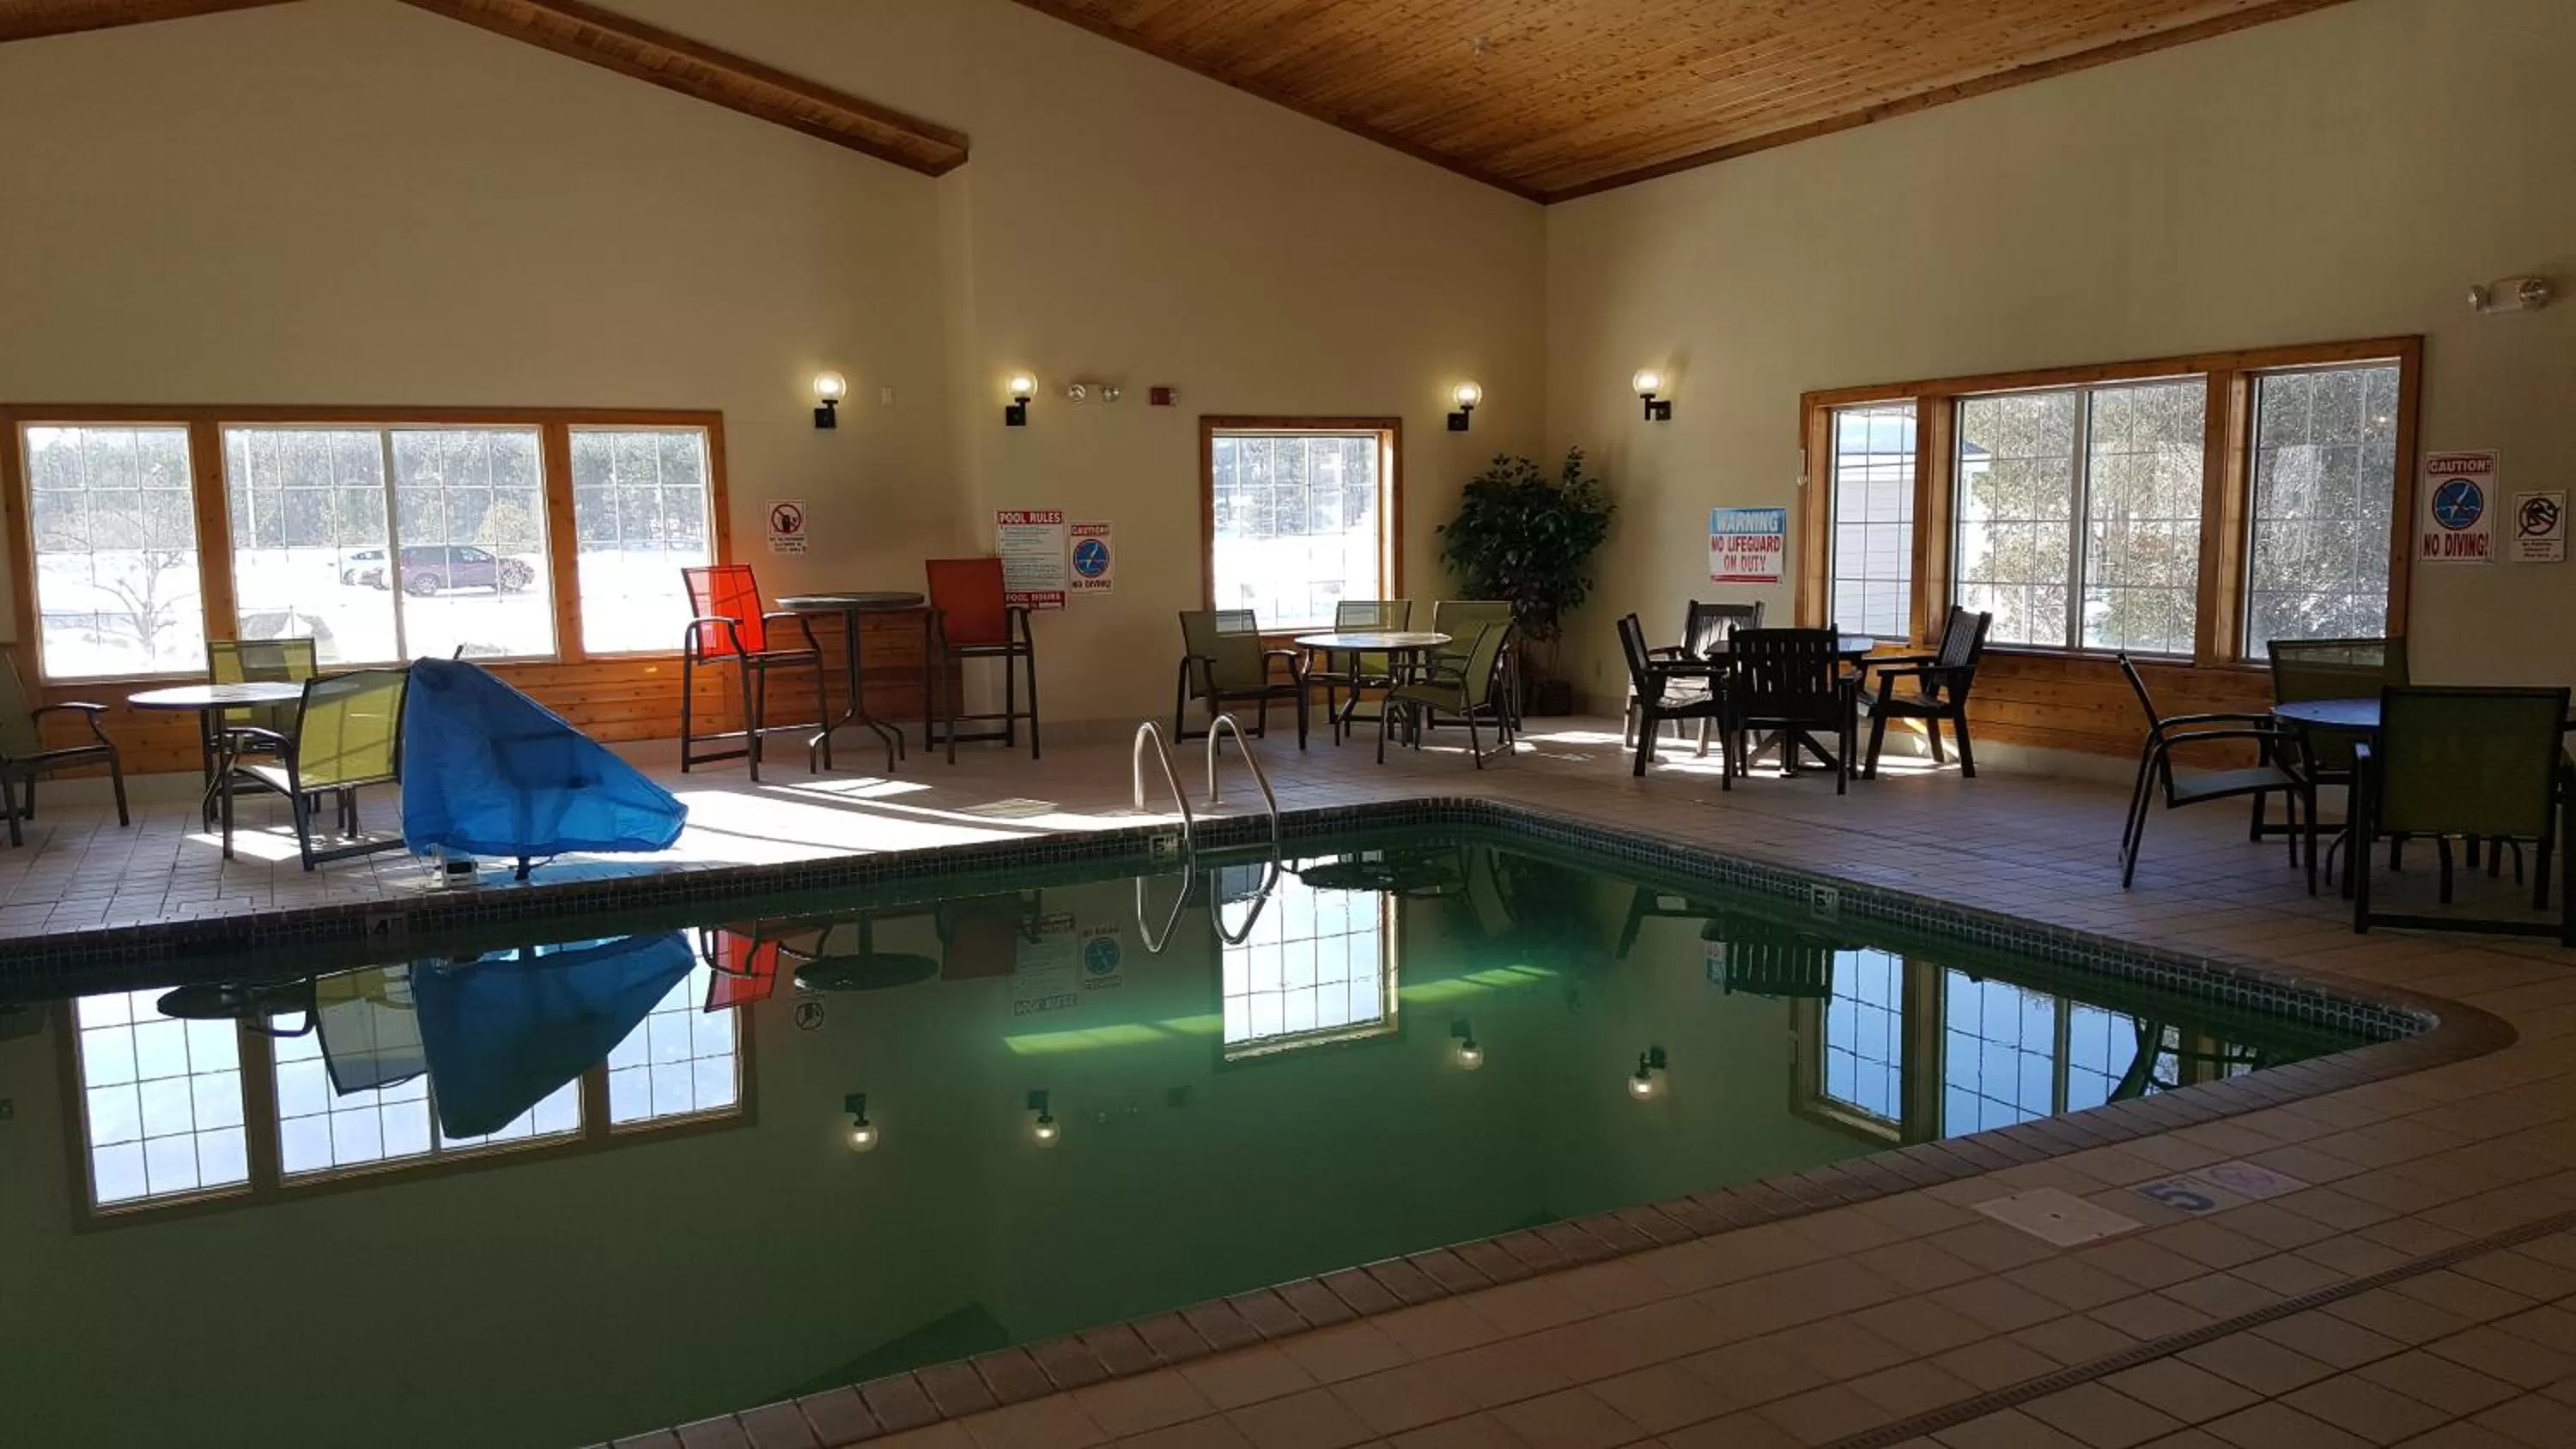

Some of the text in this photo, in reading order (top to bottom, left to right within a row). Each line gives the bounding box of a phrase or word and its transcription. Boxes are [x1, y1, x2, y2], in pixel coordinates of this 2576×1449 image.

[999, 512, 1060, 523] POOL RULES
[1716, 512, 1779, 533] WARNING
[1711, 535, 1780, 552] NO LIFEGUARD
[2423, 532, 2489, 557] NO DIVING!
[1724, 554, 1766, 573] ON DUTY
[1005, 593, 1029, 602] POOL
